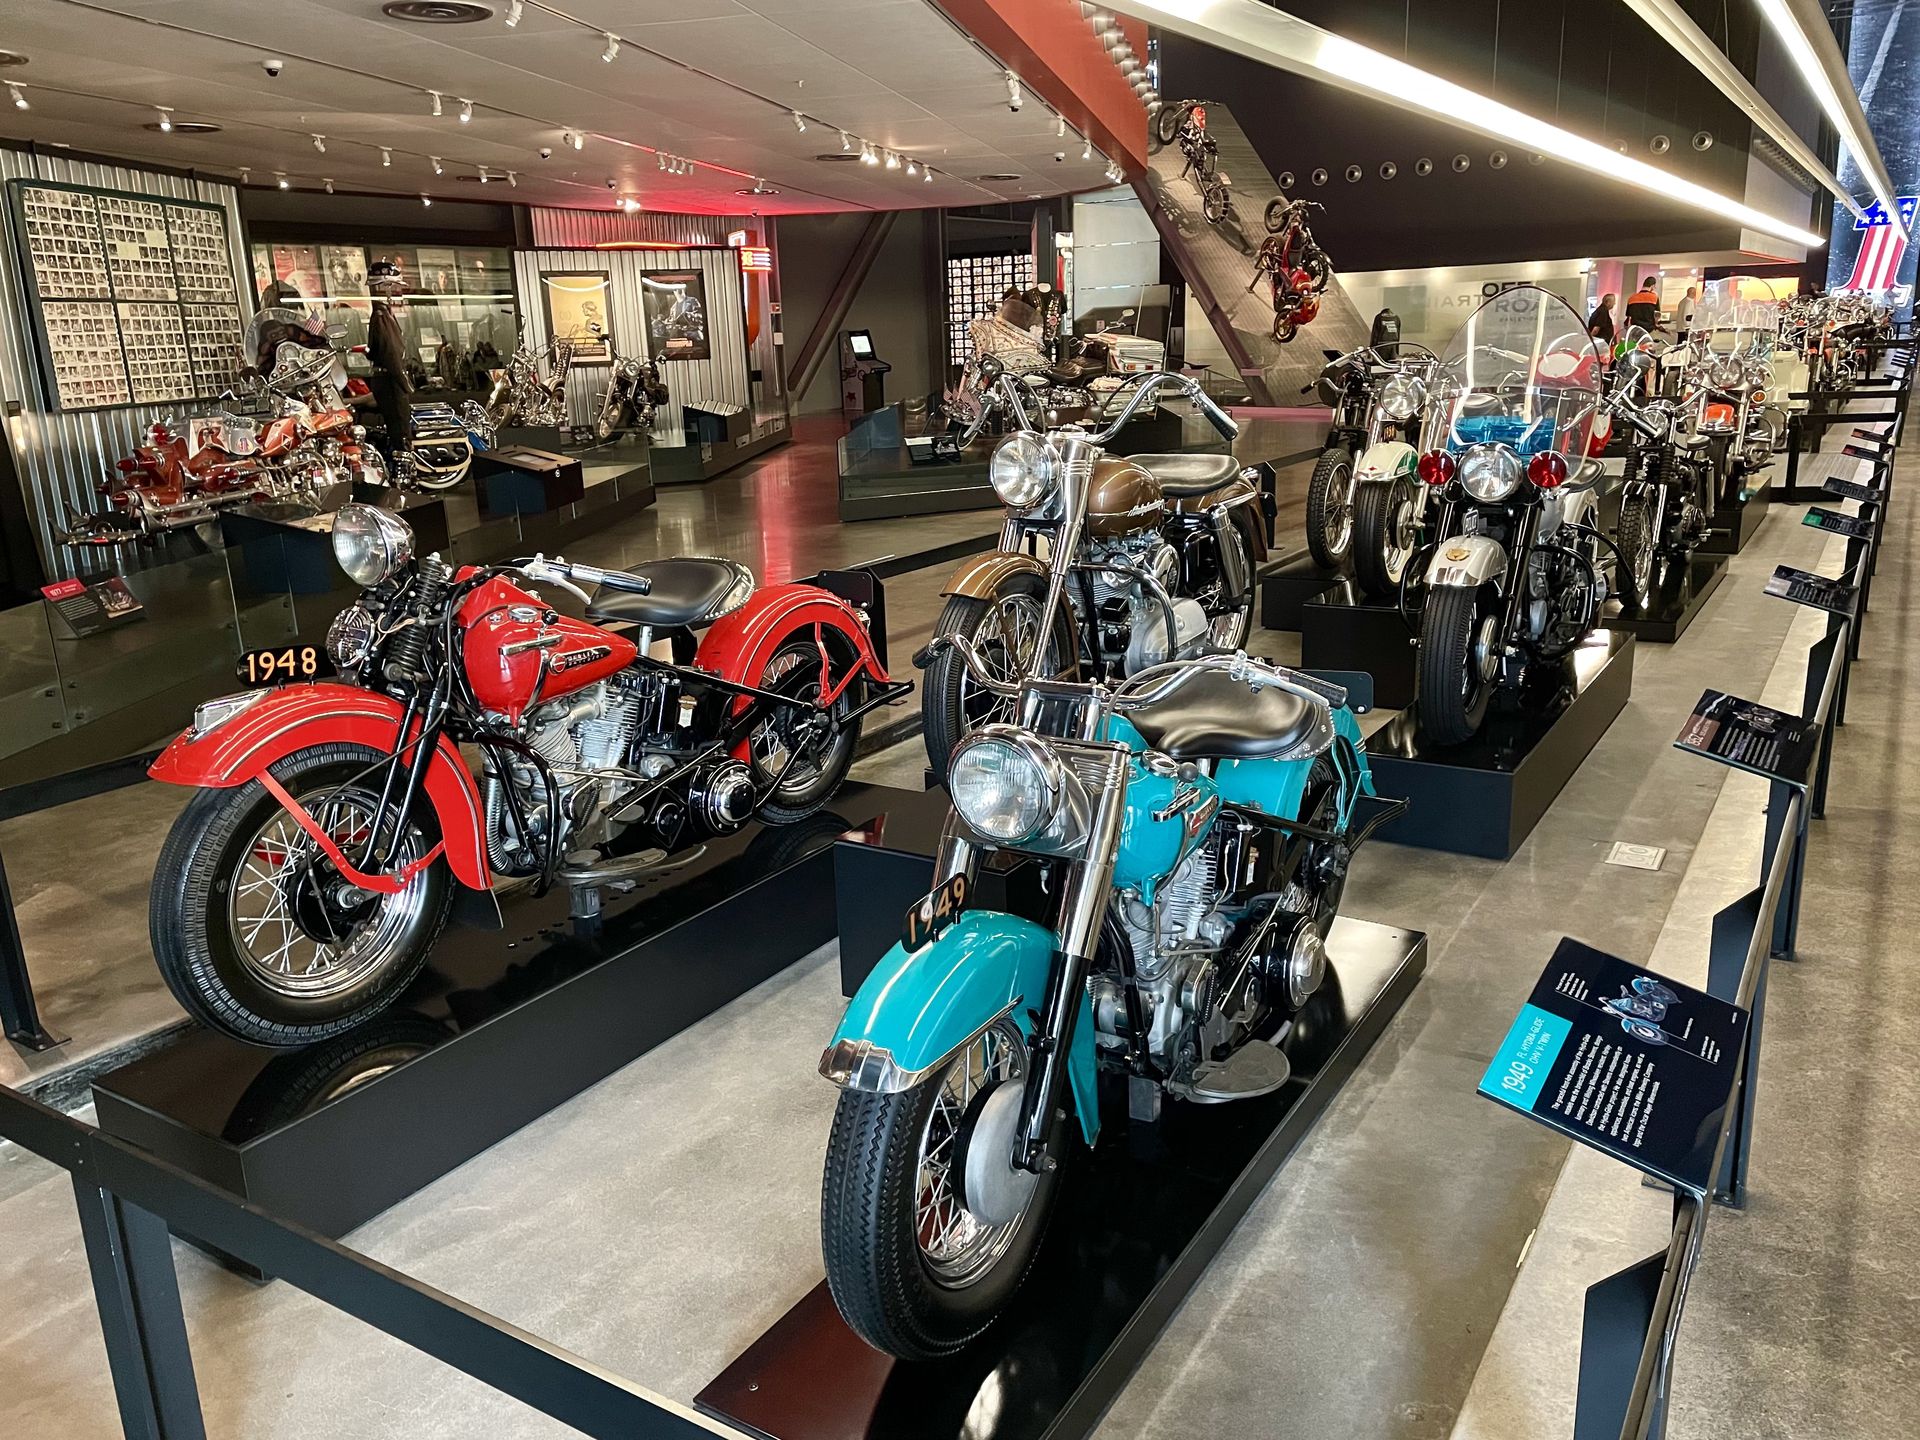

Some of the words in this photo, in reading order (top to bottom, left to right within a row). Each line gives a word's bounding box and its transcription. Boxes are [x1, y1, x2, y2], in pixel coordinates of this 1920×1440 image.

[246, 647, 317, 683] 1948
[909, 877, 965, 945] 1949
[1516, 1051, 1527, 1059] FL
[1529, 1050, 1541, 1064] OHV
[1535, 1031, 1551, 1050] V-TWIN
[1501, 1061, 1533, 1093] 1949
